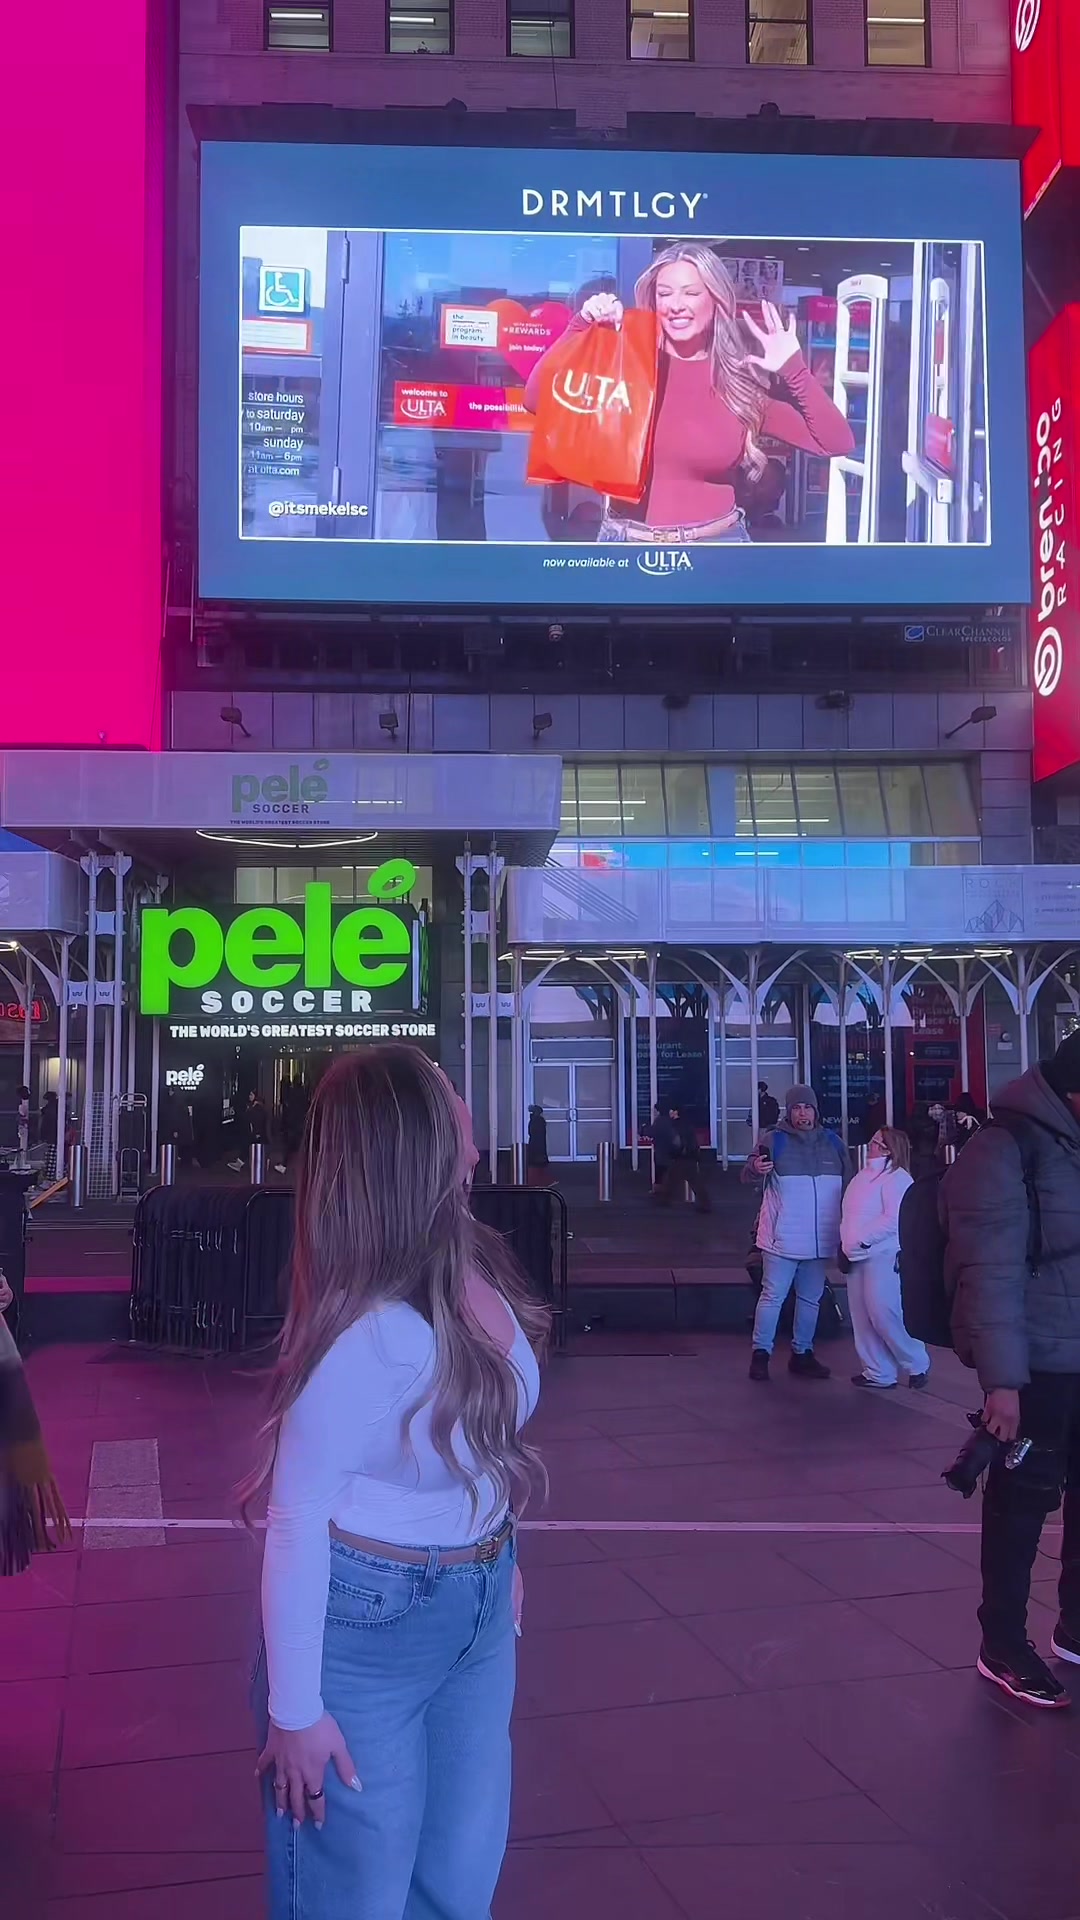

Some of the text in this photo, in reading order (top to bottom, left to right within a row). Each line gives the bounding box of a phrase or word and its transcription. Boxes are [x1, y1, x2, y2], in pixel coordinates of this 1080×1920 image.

[522, 188, 703, 219] DRMTLGY
[248, 392, 304, 403] store hours
[401, 388, 438, 396] welcome
[407, 399, 446, 414] ULTA
[469, 402, 482, 410] the
[246, 409, 304, 422] to saturday
[249, 422, 273, 432] 10am
[263, 437, 304, 451] sunday
[284, 452, 302, 461] 6pm
[268, 501, 368, 517] @itsmekelsc
[1051, 398, 1067, 606] RACING
[543, 557, 629, 568] now available at
[644, 551, 691, 568] ULTA
[231, 758, 330, 813] pelé
[252, 804, 310, 814] SOCCER
[140, 858, 416, 1015] pelé
[200, 990, 372, 1014] SOCCER
[170, 1024, 436, 1038] THE WORLD'S GREATEST SOCCER STORE
[166, 1063, 205, 1086] pelé
